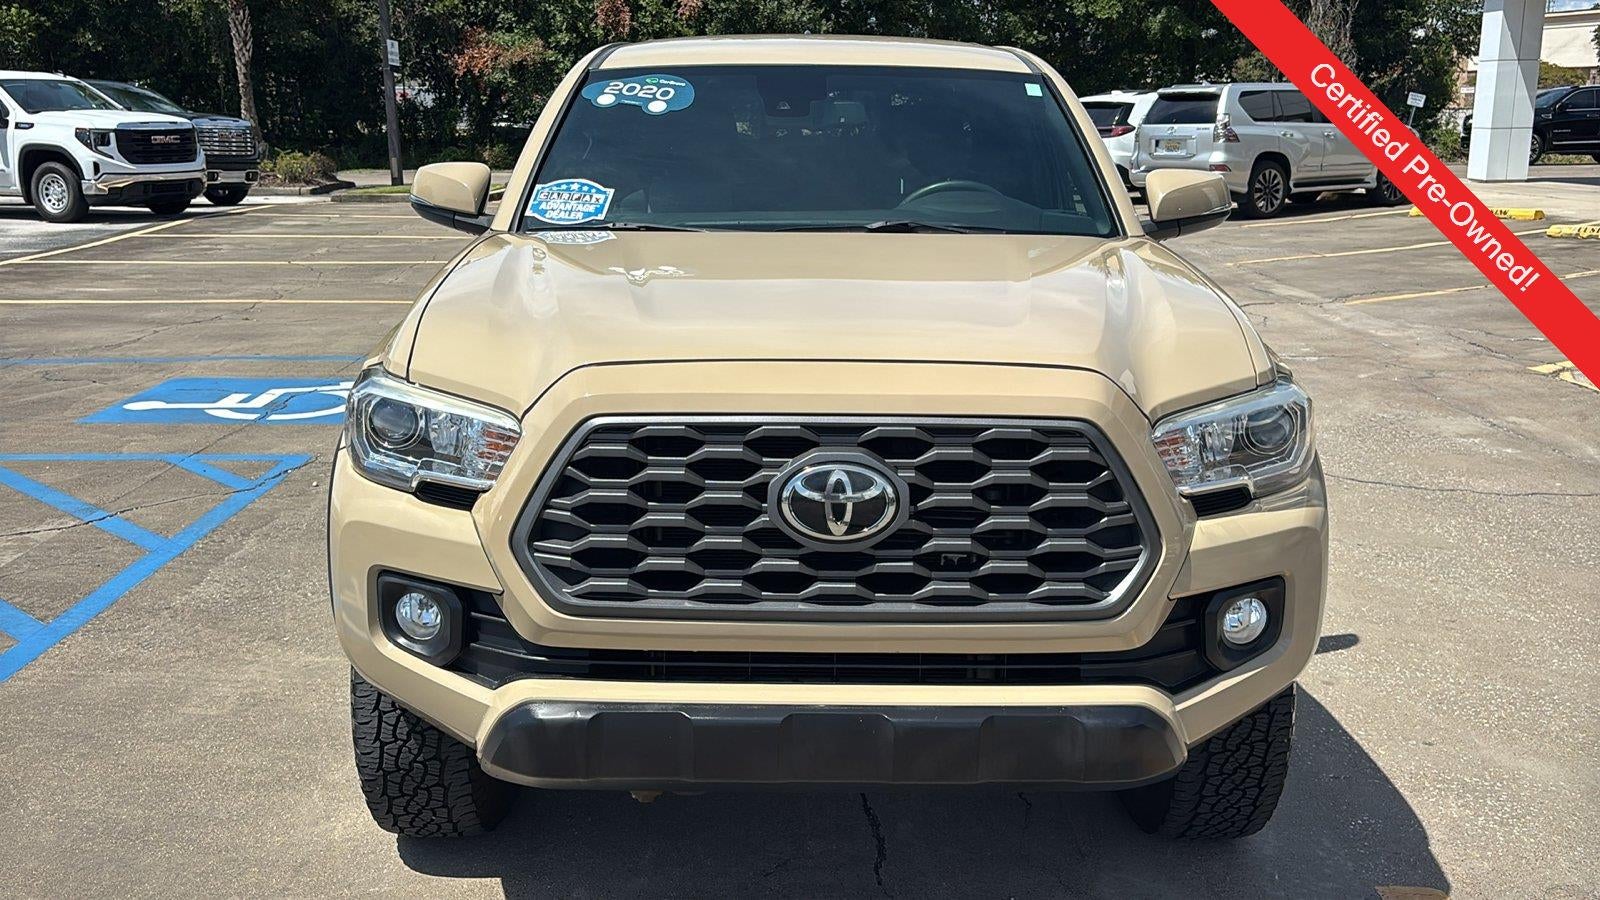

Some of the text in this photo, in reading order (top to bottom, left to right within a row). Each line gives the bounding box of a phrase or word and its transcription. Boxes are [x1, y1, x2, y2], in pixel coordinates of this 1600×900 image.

[603, 81, 676, 100] 2020
[151, 135, 181, 144] GMC
[539, 191, 605, 204] CARFAX
[538, 201, 597, 213] ADVANTAGE
[545, 210, 584, 220] DEALER
